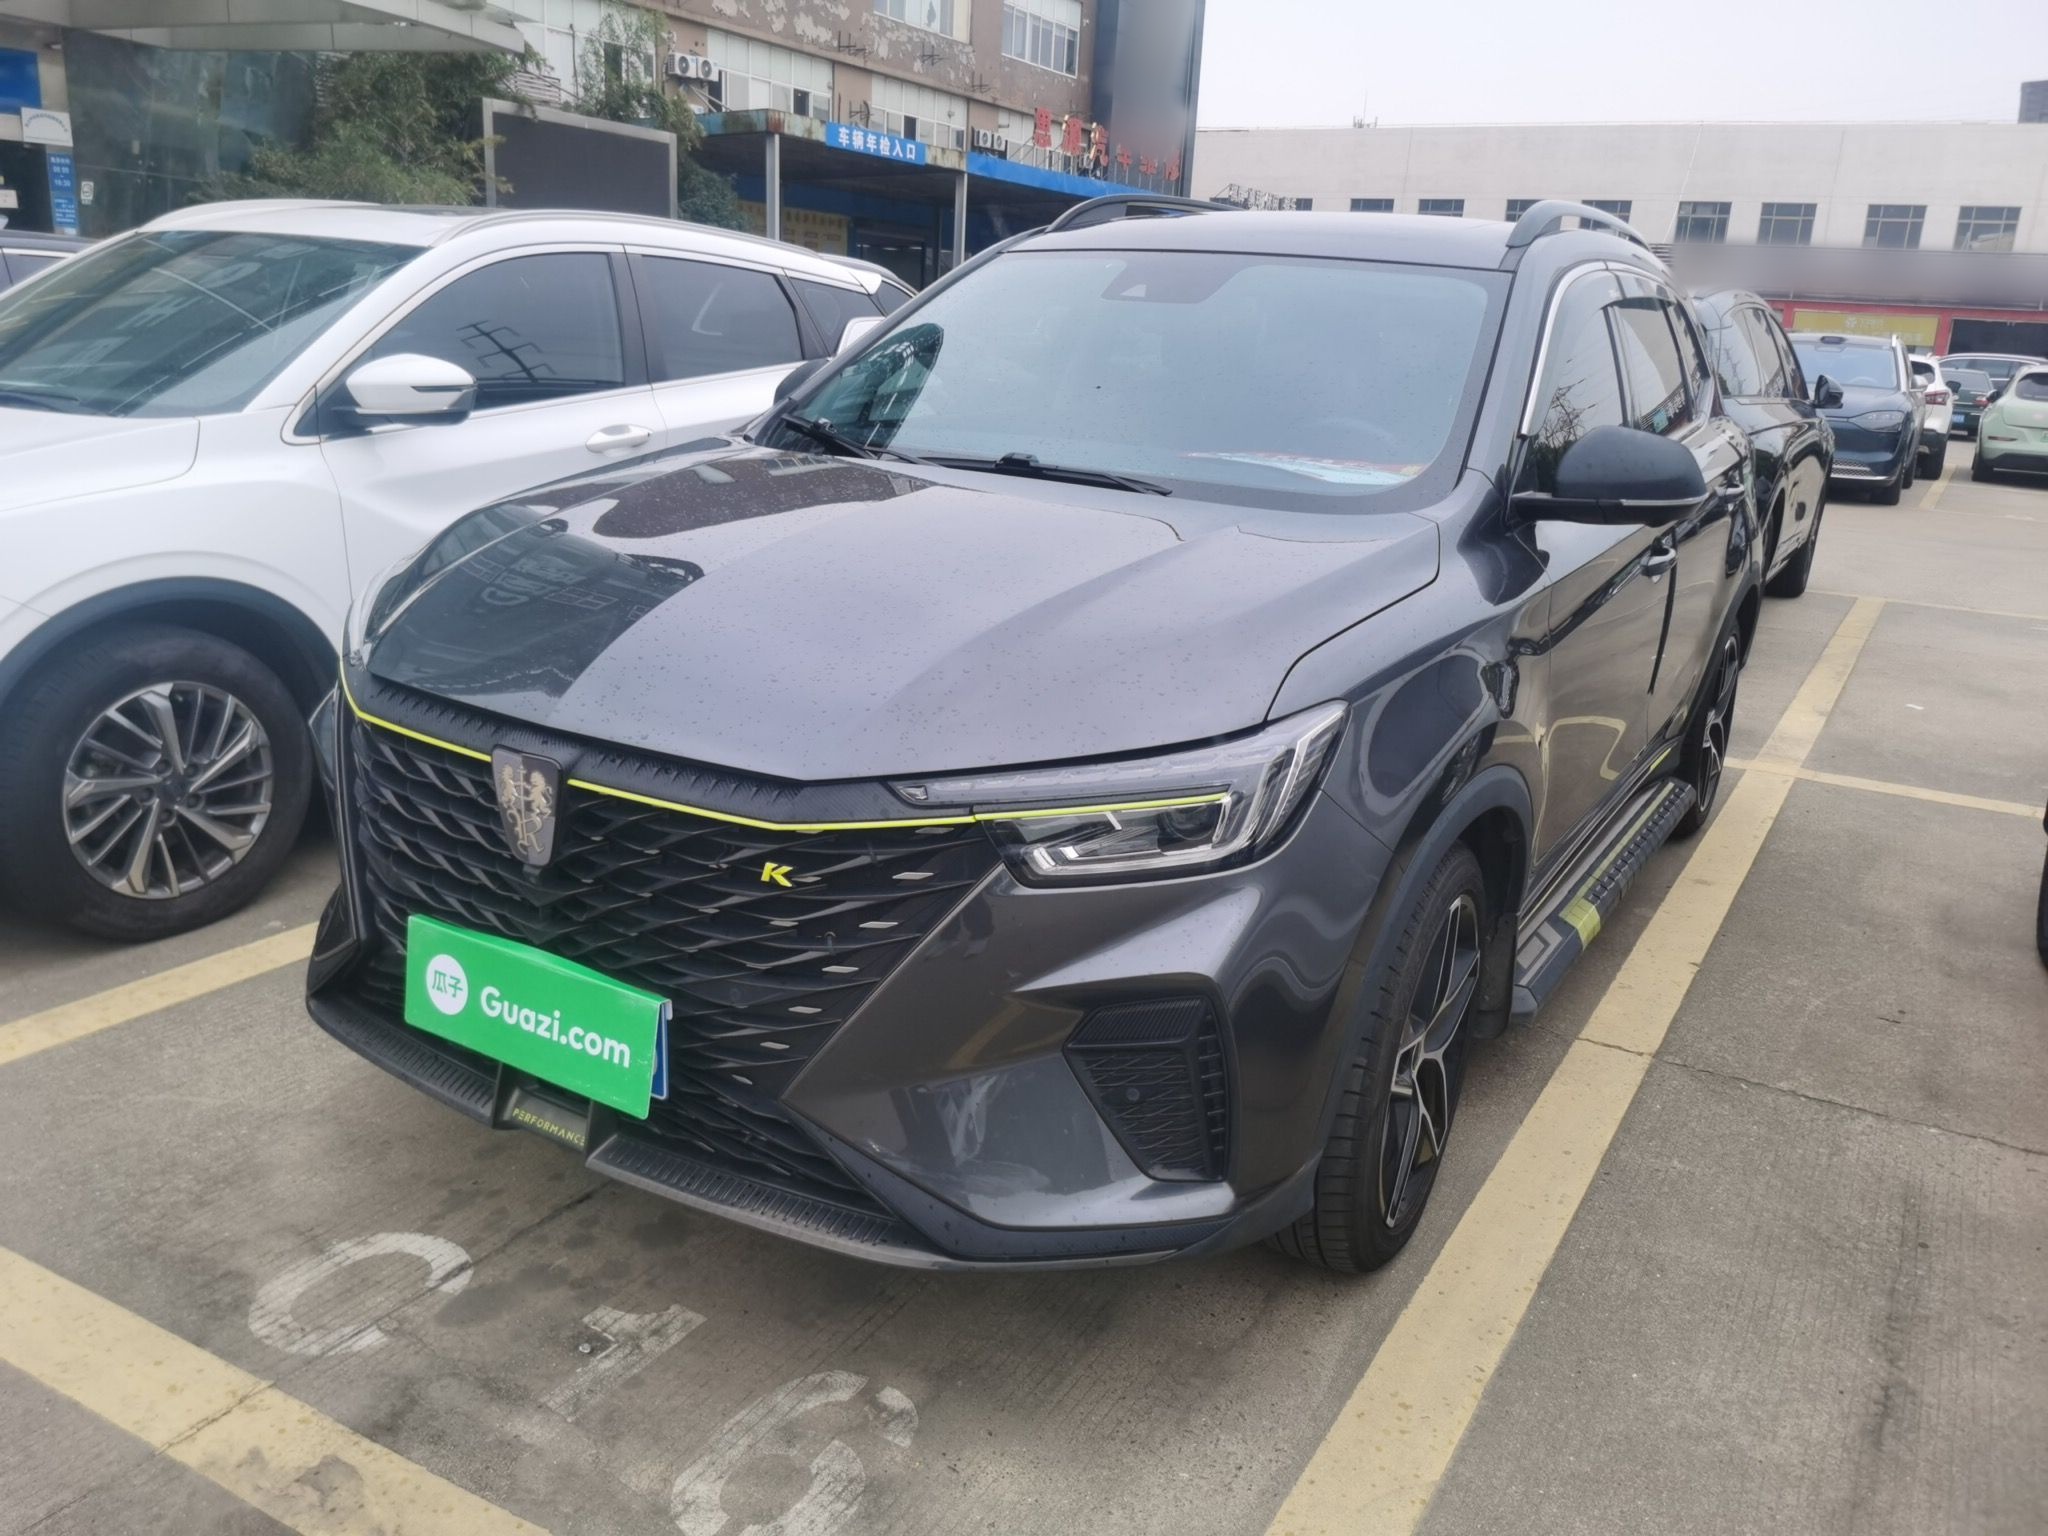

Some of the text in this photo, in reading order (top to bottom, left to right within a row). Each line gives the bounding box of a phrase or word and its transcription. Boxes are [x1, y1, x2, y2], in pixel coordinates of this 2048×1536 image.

[838, 126, 916, 160] 车辆年检入口
[760, 861, 793, 887] K
[432, 970, 463, 998] 瓜子
[480, 986, 631, 1068] Guazi.com
[512, 1108, 586, 1147] PERFORMANCE
